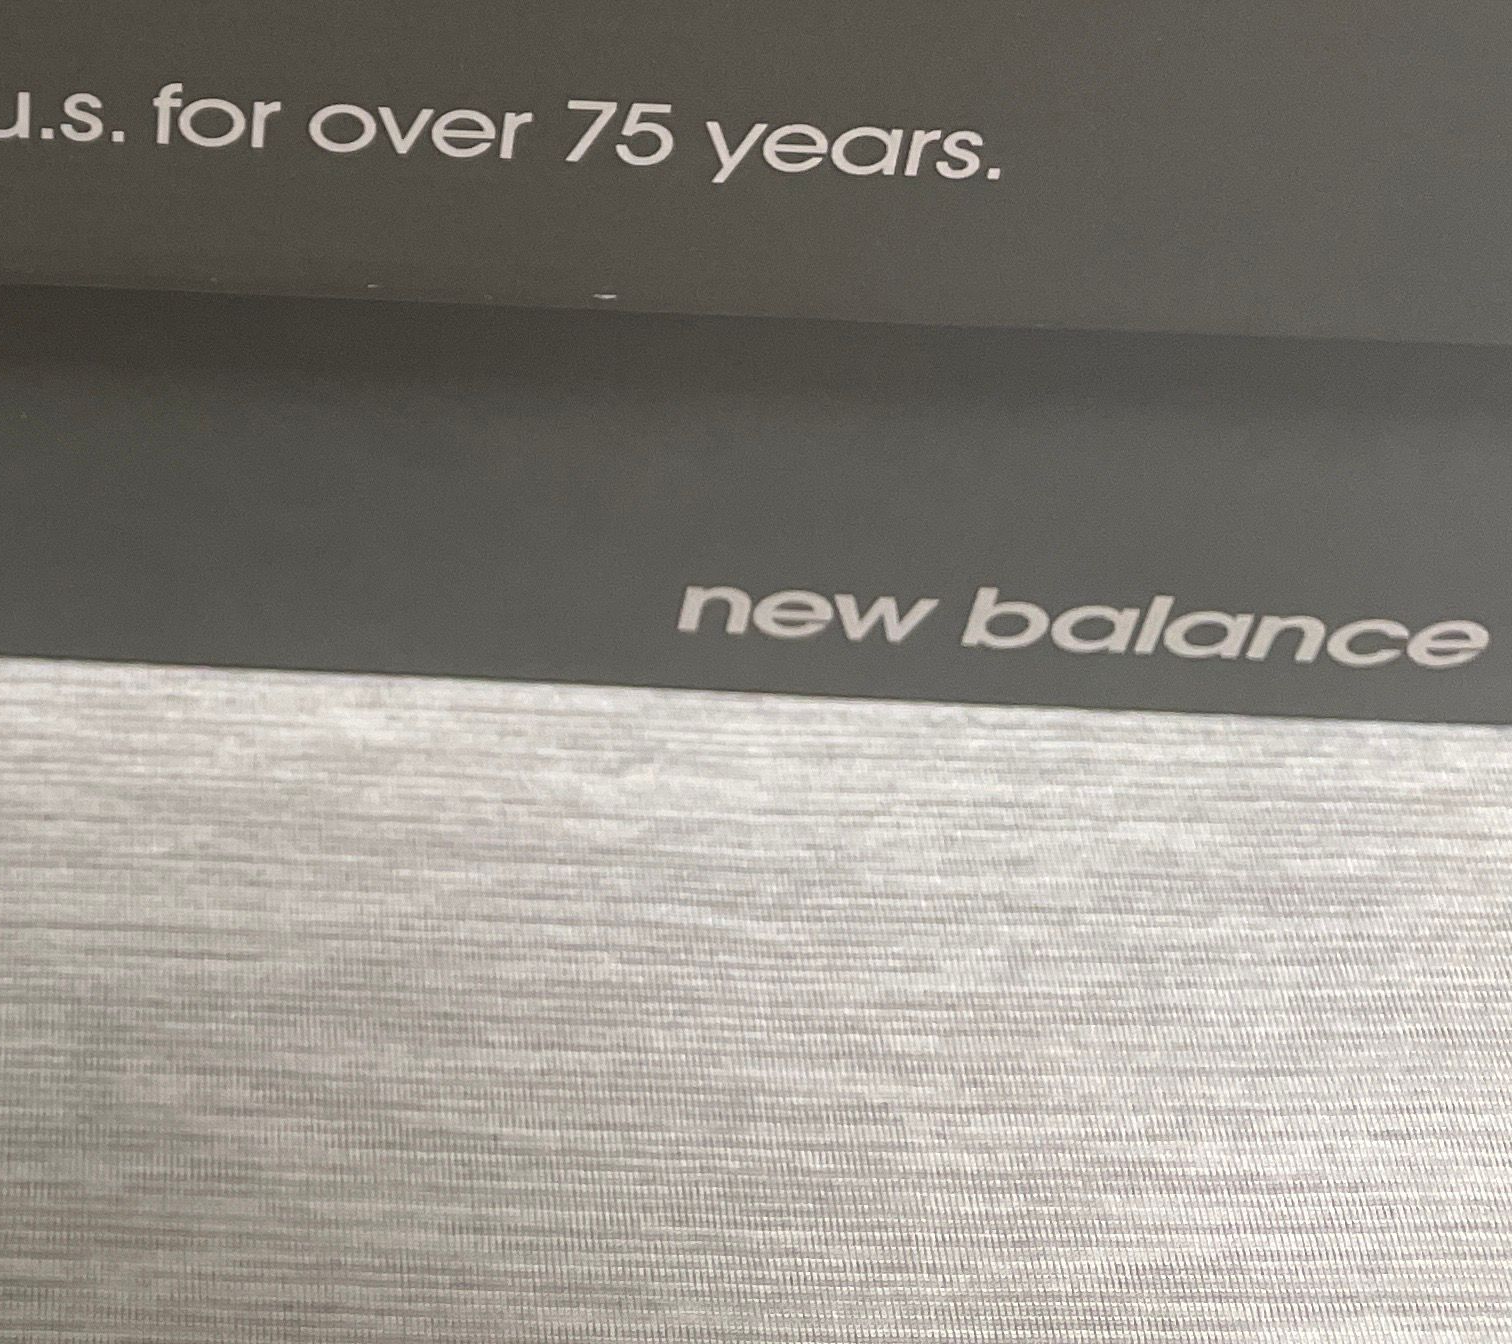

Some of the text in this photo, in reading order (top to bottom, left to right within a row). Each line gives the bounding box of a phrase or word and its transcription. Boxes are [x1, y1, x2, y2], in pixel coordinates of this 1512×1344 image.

[152, 81, 282, 149] for
[308, 103, 534, 160] over
[564, 99, 675, 167] 75
[705, 120, 1002, 185] years.
[677, 584, 1491, 668] new balance
